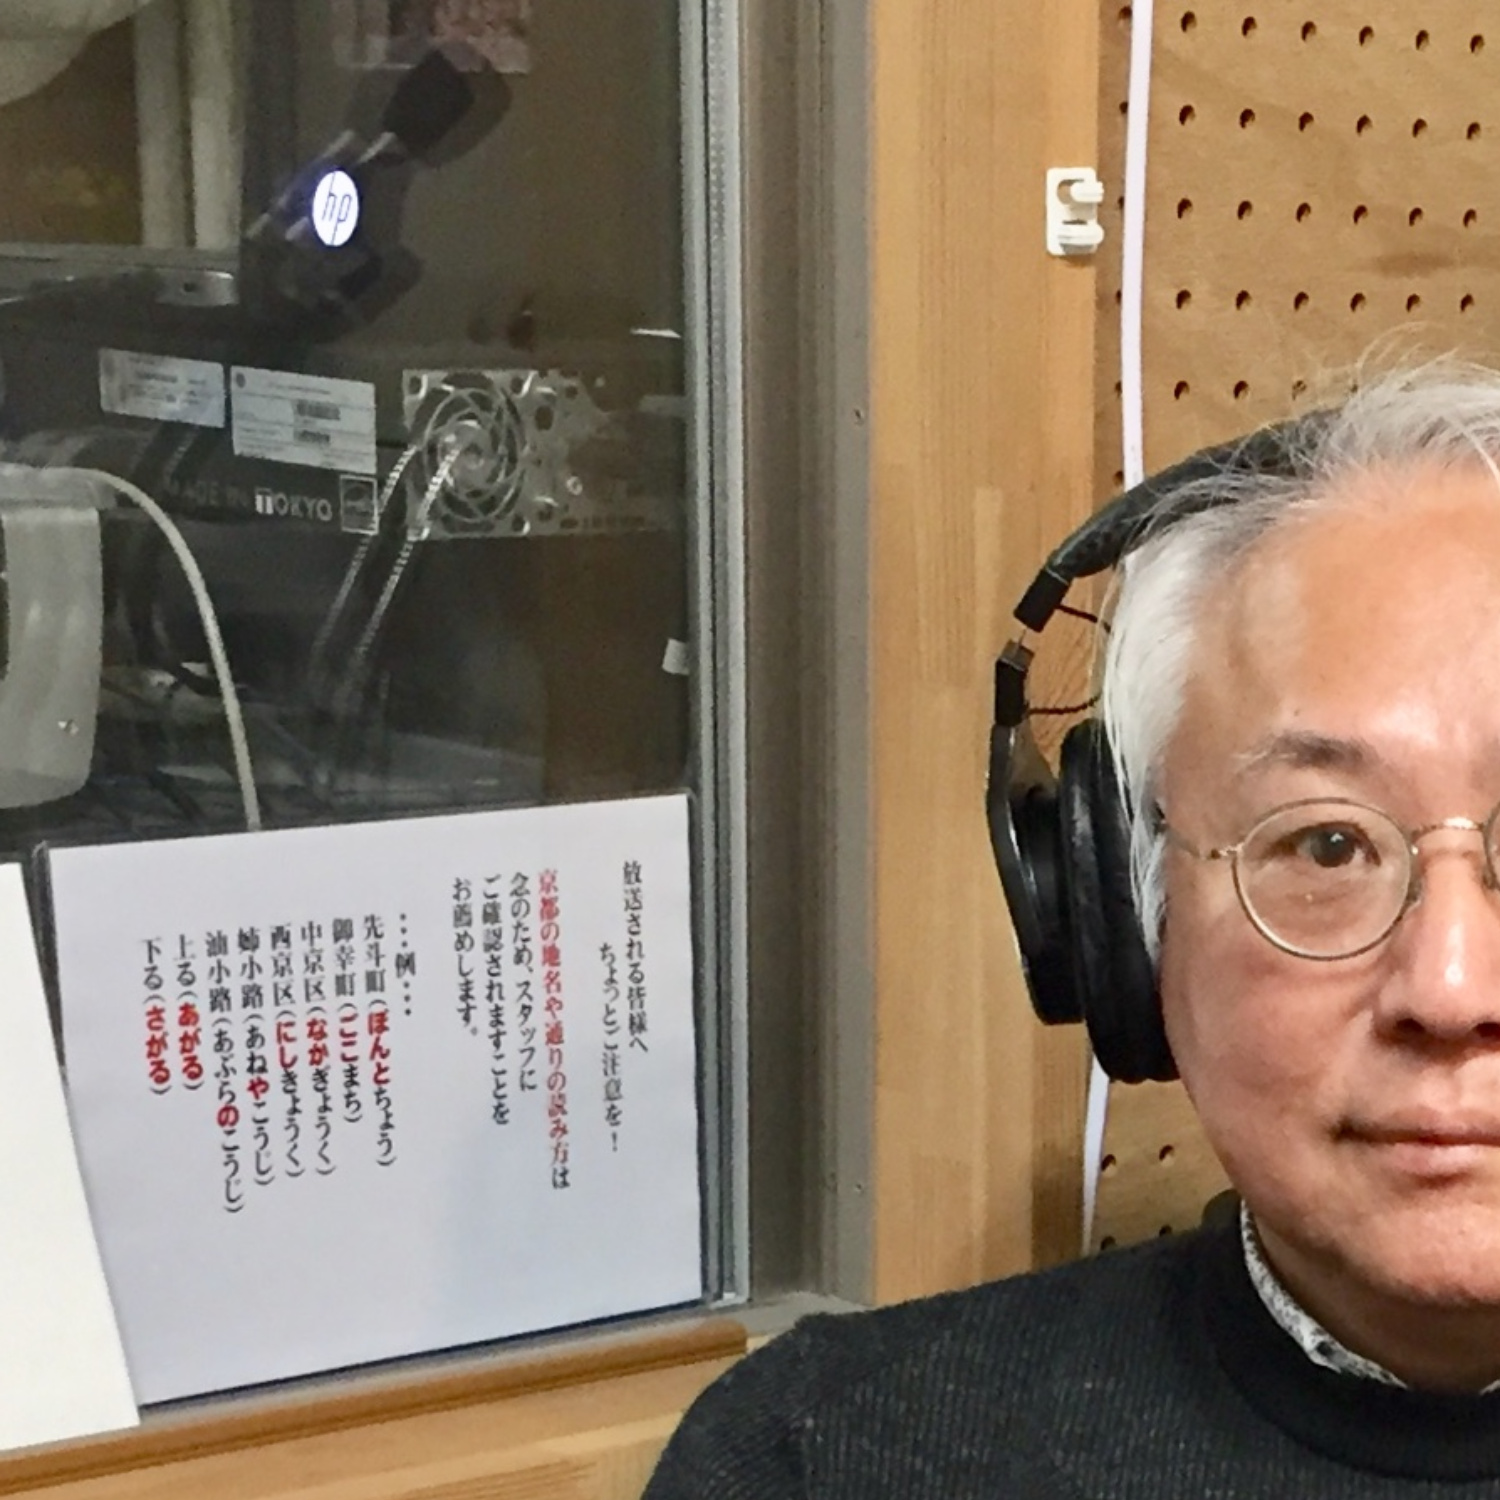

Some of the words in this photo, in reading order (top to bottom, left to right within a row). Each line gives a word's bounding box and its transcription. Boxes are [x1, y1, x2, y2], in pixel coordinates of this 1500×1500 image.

[321, 171, 352, 246] hp
[255, 487, 333, 521] TOKYO
[482, 873, 510, 1126] ご確認されますことを
[509, 871, 538, 1092] 念のため、スタッフに
[538, 867, 571, 1190] 京都の地名や通りの読み方は
[622, 860, 648, 1053] 放送される皆様へ
